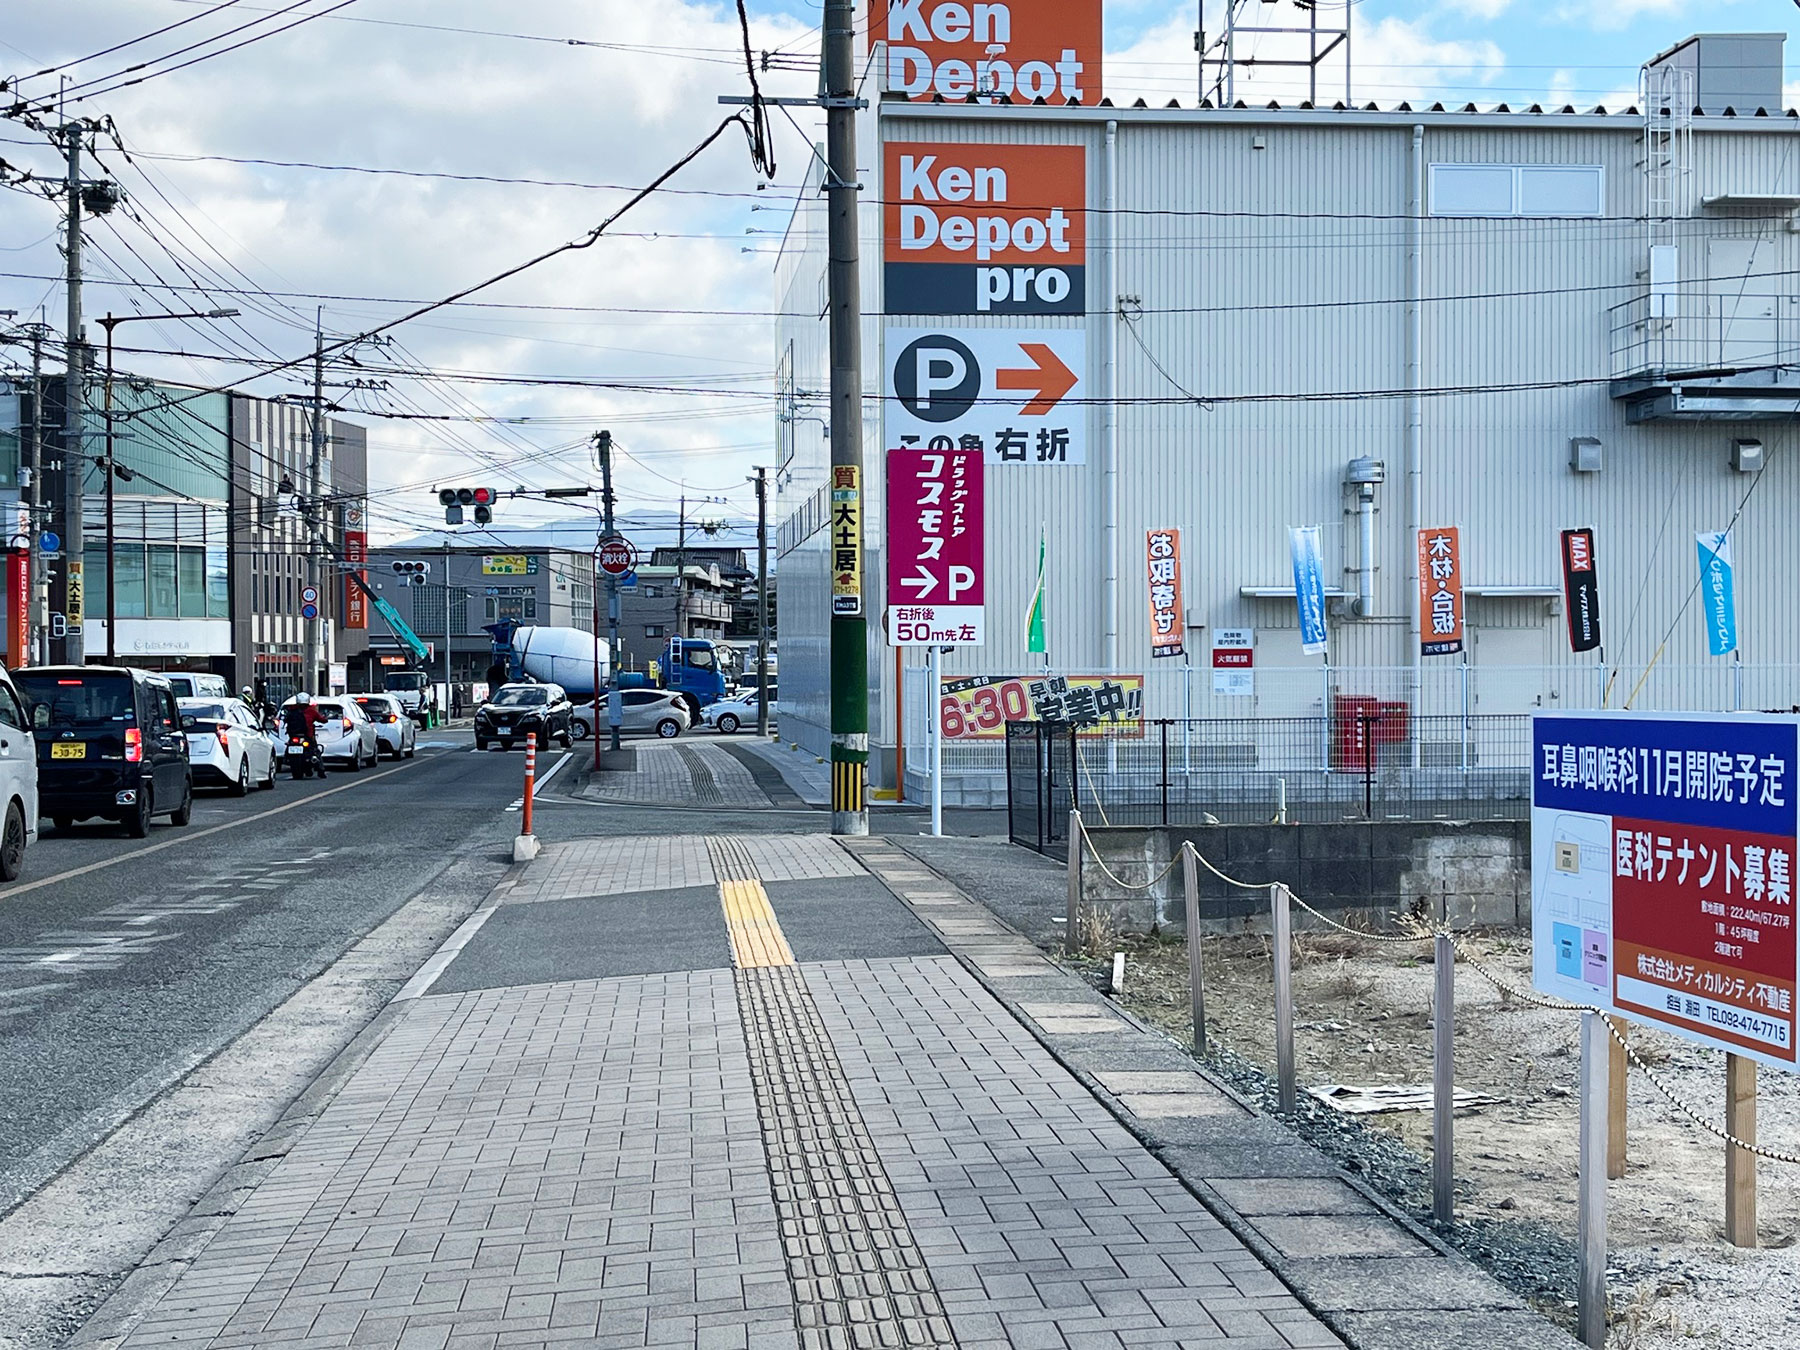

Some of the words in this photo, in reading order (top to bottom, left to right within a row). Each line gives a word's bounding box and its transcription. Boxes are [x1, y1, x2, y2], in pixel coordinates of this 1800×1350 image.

[888, 0, 1010, 42] Ken
[888, 47, 1083, 104] Depot
[900, 155, 1007, 201] Ken
[901, 208, 1070, 260] Depot
[976, 267, 1071, 311] pro
[995, 427, 1070, 462] 右折
[834, 466, 856, 489] 質
[950, 455, 968, 538] ドラッグストア
[916, 454, 945, 560] コスモス
[602, 552, 628, 565] 消火栓
[834, 503, 857, 571] 大土居
[1572, 536, 1589, 569] MAX
[69, 581, 81, 614] 大土居
[304, 591, 315, 599] 40
[949, 565, 975, 601] P
[896, 608, 935, 621] 右折後
[941, 682, 1028, 737] 6:30
[1542, 743, 1785, 807] 耳鼻咽喉科11月開院予定
[1616, 829, 1791, 906] 医科テナント募集
[1637, 953, 1791, 1013] 株式会社メディカルシティ不動産
